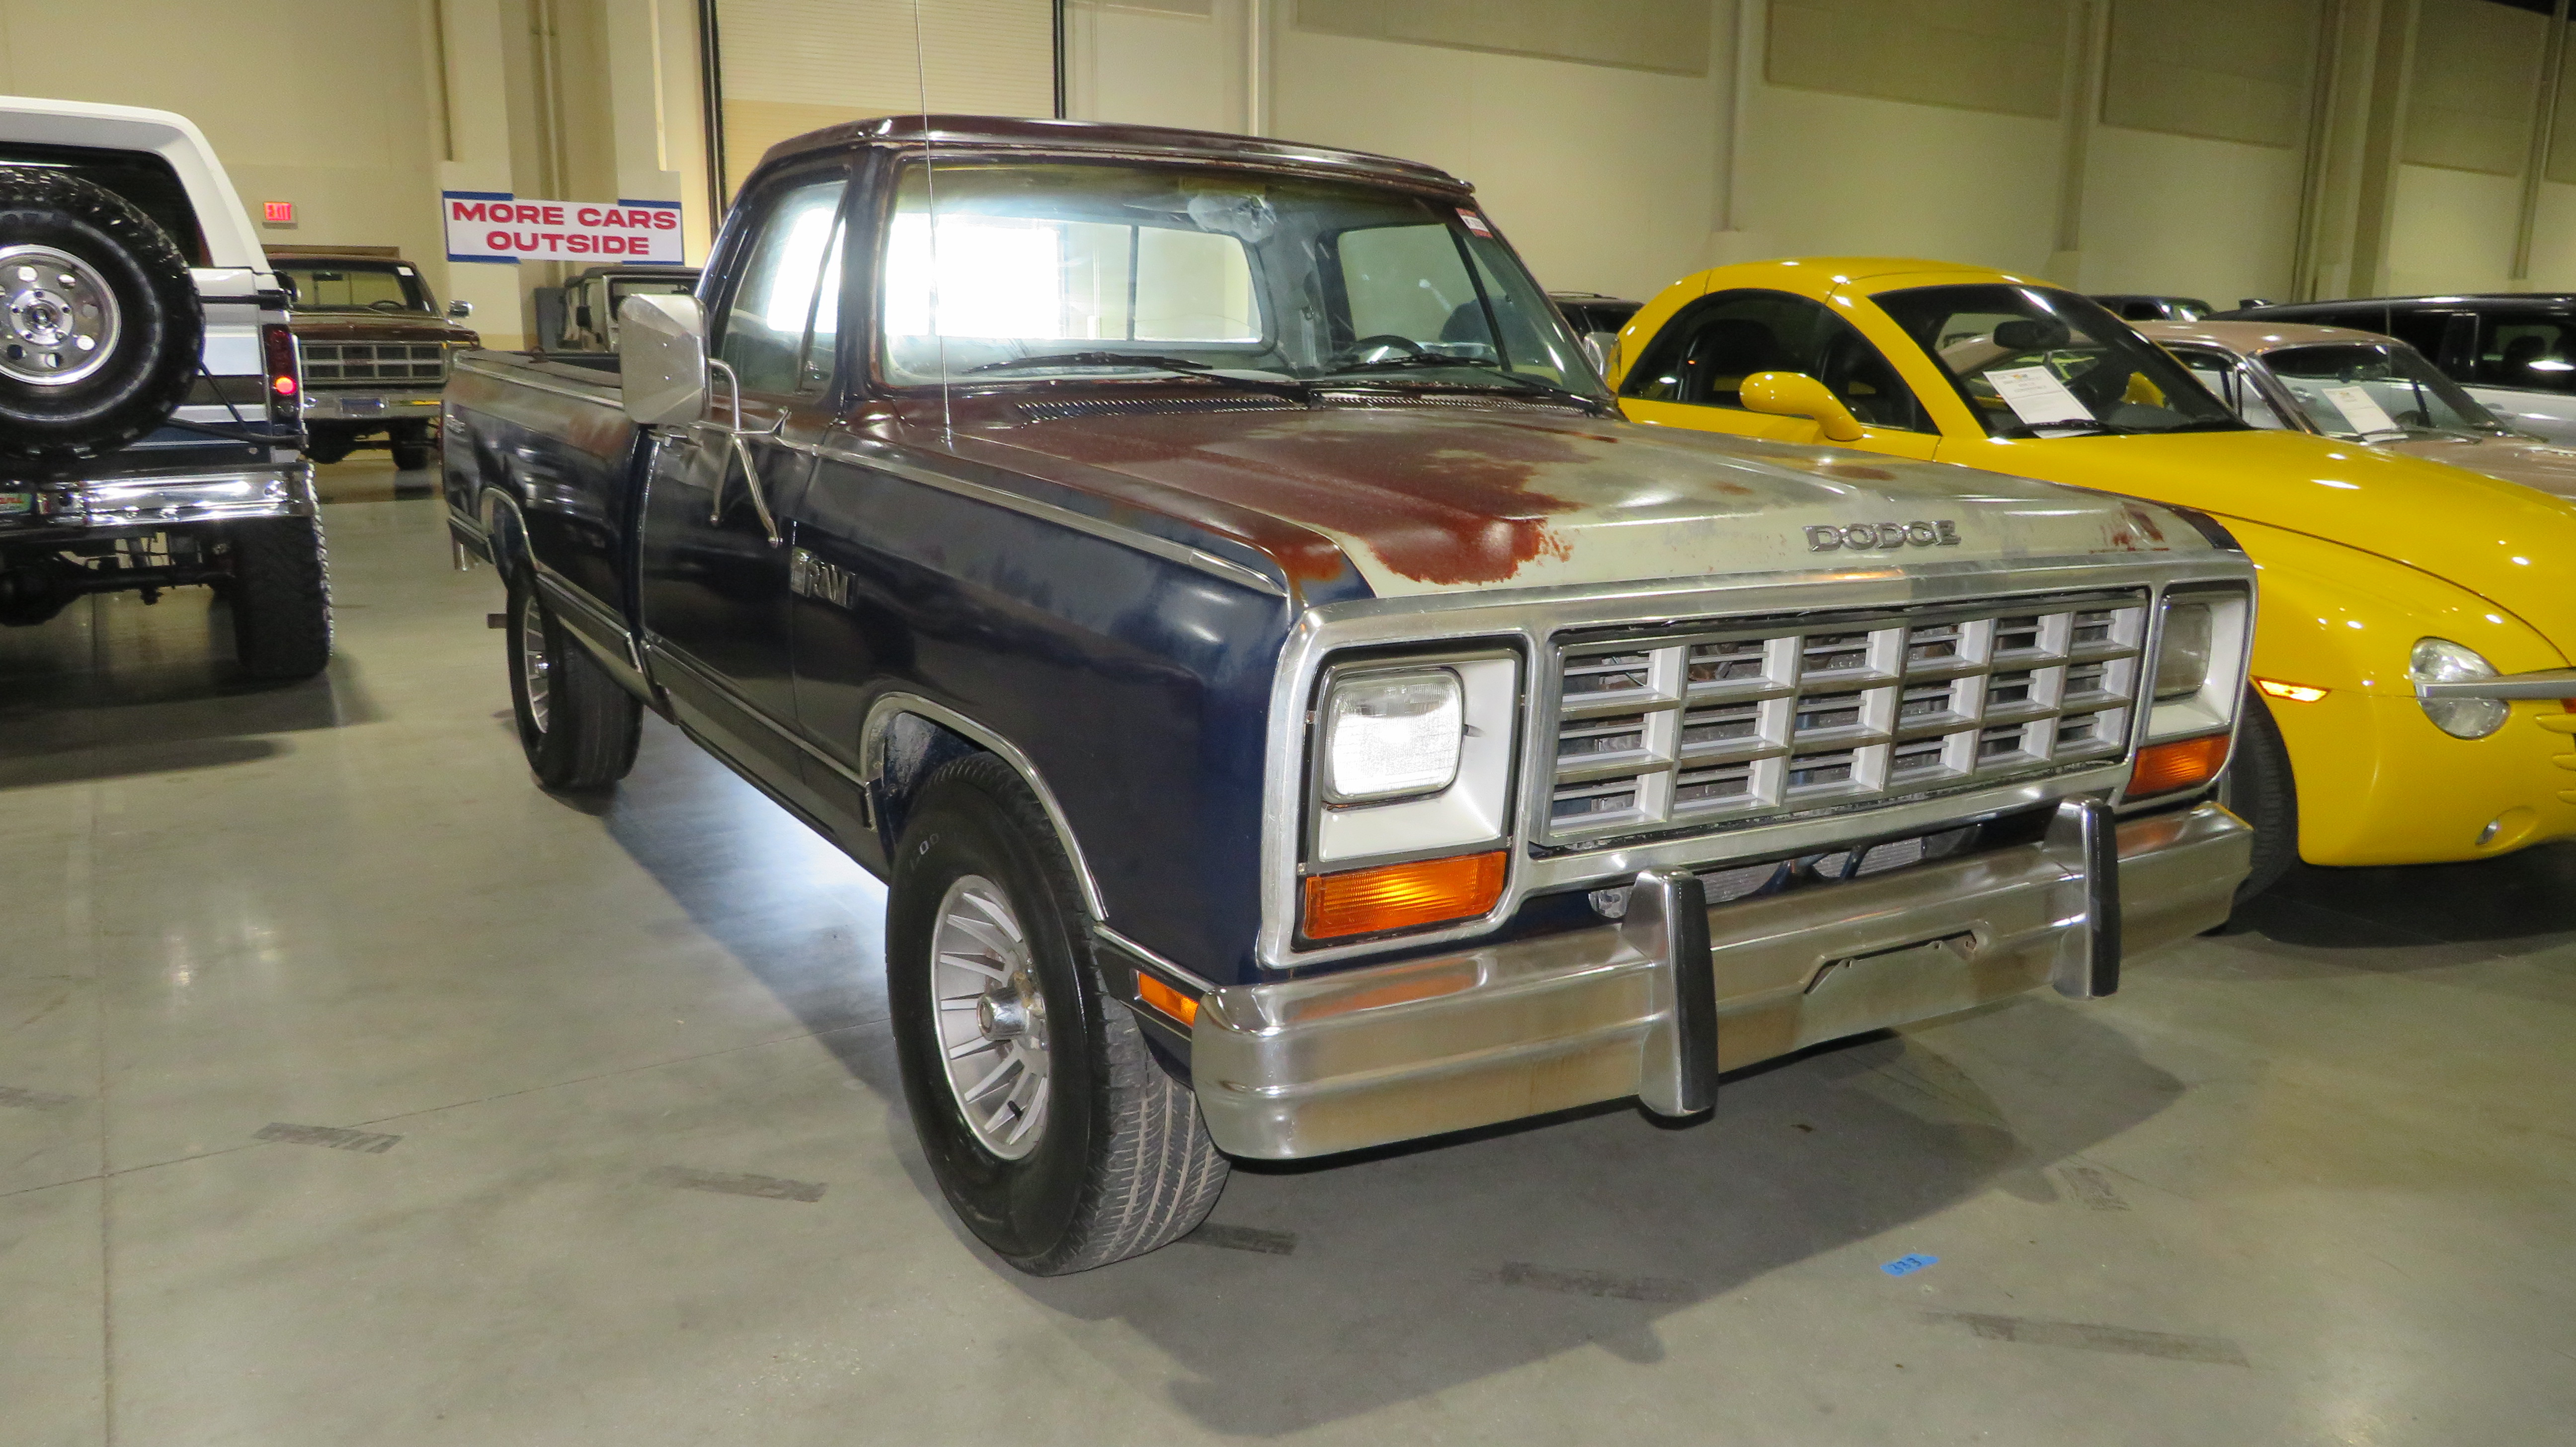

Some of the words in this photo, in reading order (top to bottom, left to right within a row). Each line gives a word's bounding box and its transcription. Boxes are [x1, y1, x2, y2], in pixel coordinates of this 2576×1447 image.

[452, 202, 564, 226] MORE
[577, 208, 677, 230] CARS
[486, 231, 649, 255] OUTSIDE
[1802, 519, 1962, 552] DODGE
